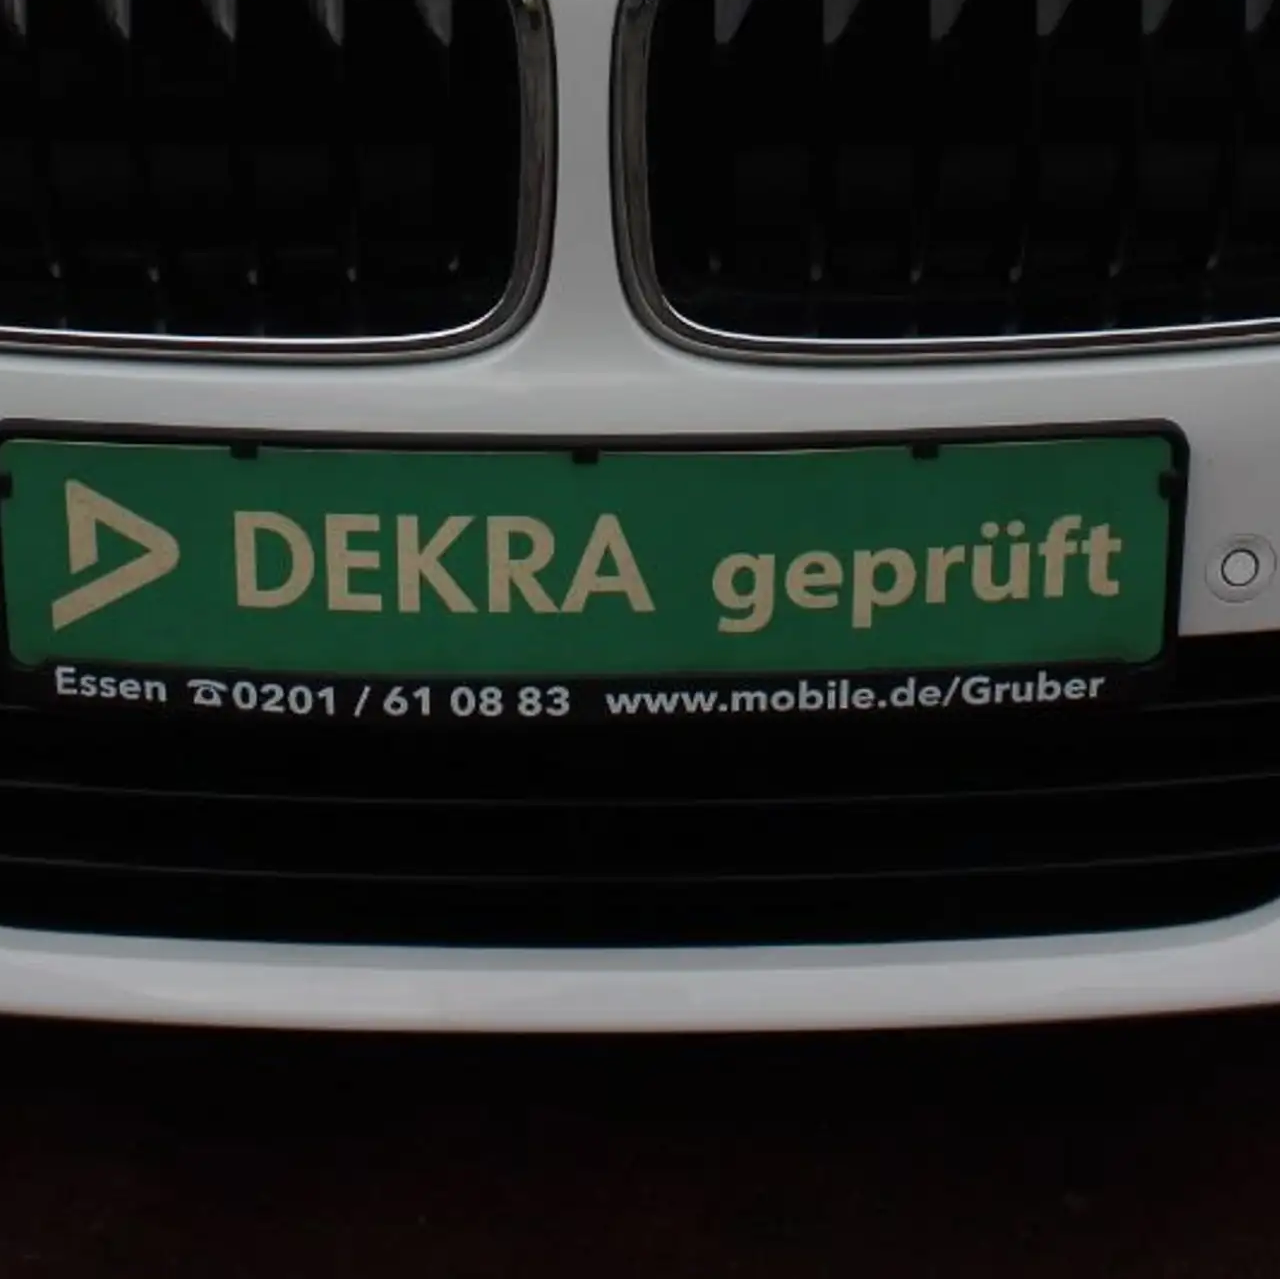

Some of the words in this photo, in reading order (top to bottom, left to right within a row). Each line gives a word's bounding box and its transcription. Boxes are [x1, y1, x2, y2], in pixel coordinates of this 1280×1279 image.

[233, 509, 656, 614] DEKRA
[711, 514, 1122, 633] geprüft
[54, 665, 168, 702] Essen
[231, 680, 336, 716] 0201
[382, 685, 431, 716] 61
[449, 685, 504, 717] 08
[516, 685, 571, 717] 83
[605, 670, 1106, 715] www.mobile.de/Gruber
